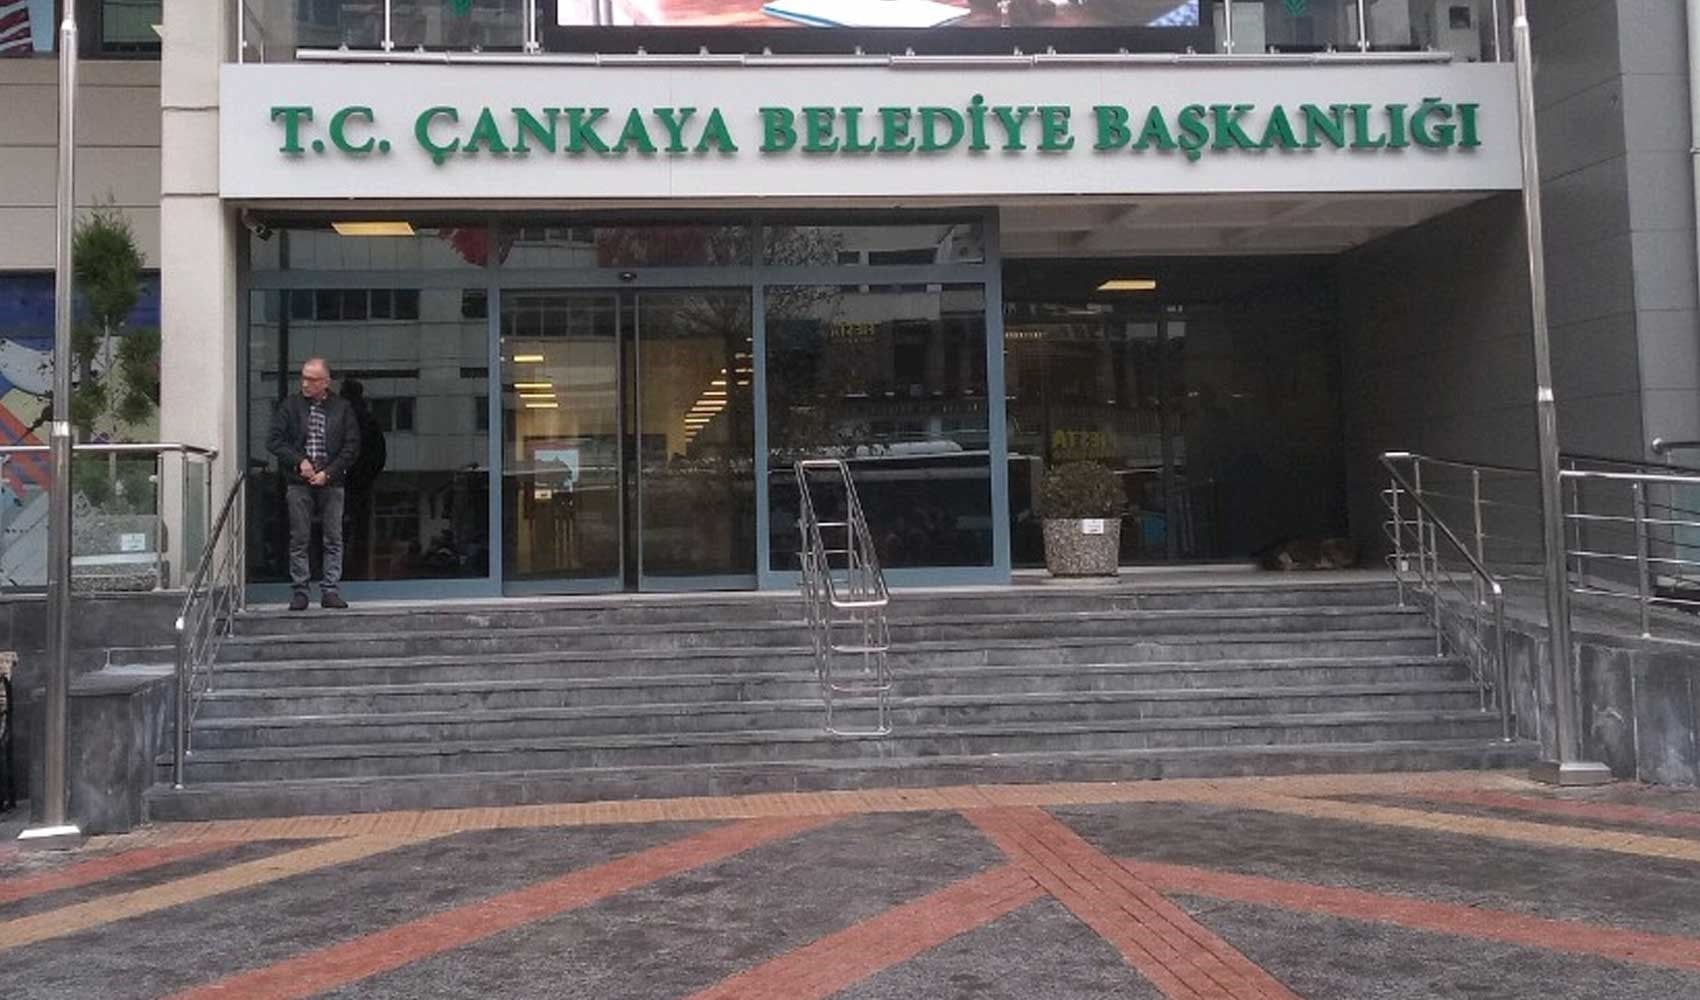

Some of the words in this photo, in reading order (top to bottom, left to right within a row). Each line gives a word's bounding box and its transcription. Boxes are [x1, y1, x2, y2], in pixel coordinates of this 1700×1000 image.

[271, 106, 390, 152] T.C.
[415, 106, 739, 167] ÇANKAYA
[759, 94, 1075, 152] BELEDİYE
[1093, 97, 1480, 163] BAŞKANLIĞI
